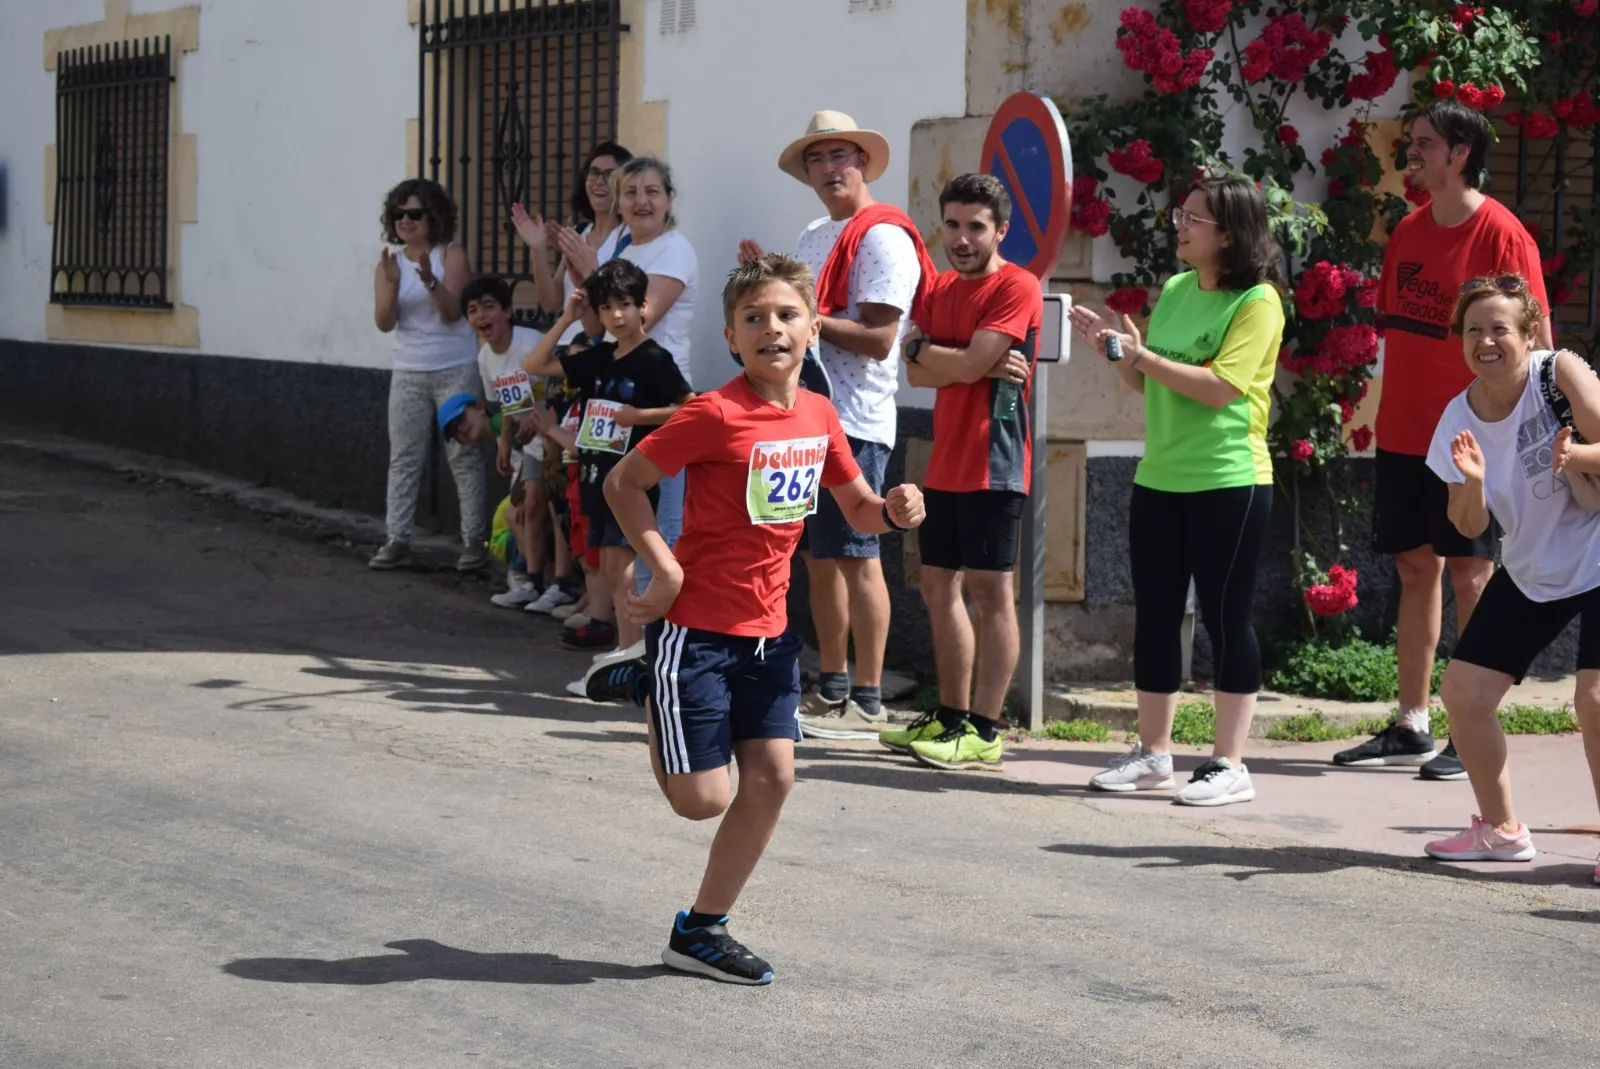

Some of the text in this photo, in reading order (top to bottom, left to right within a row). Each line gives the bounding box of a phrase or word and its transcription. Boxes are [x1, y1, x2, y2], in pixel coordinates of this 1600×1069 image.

[1397, 262, 1439, 299] Vega
[1396, 295, 1449, 323] Tirados
[589, 418, 616, 439] 281
[752, 443, 826, 472] bedunia
[768, 467, 815, 504] 262
